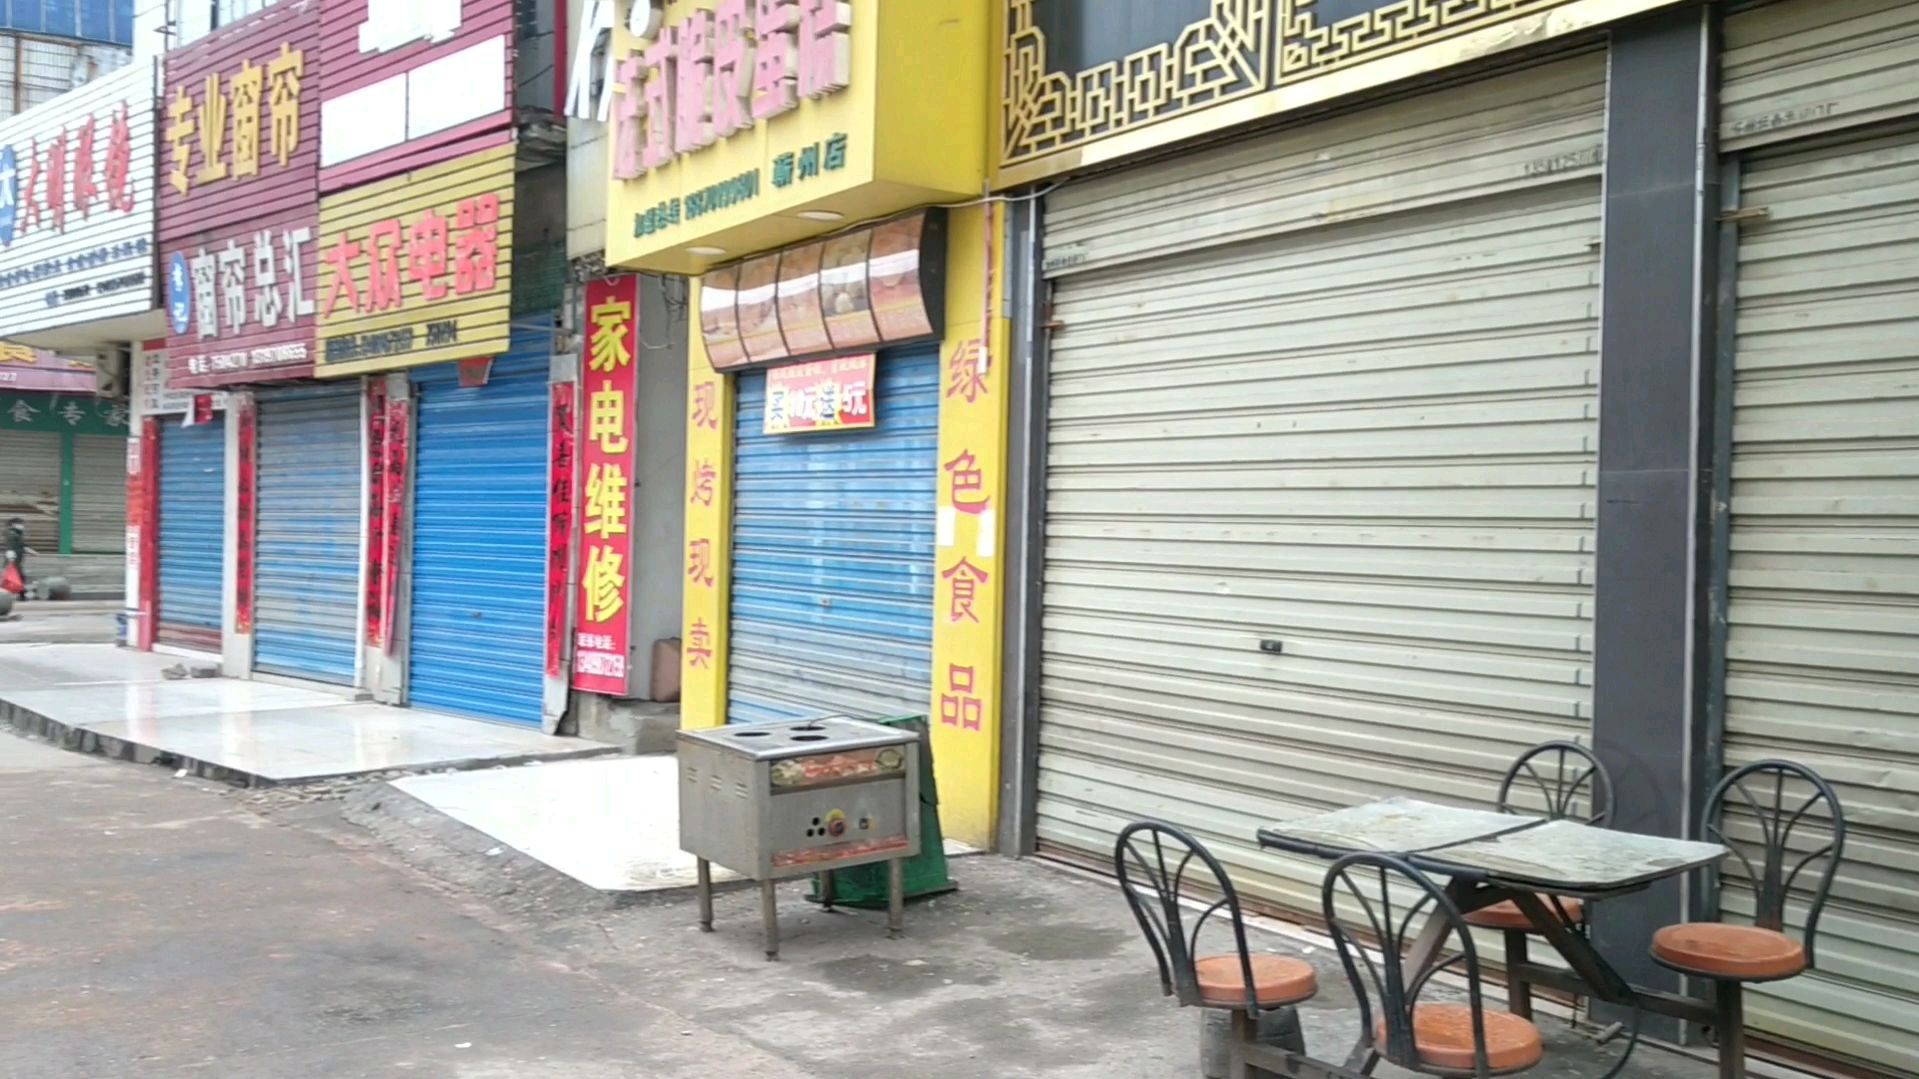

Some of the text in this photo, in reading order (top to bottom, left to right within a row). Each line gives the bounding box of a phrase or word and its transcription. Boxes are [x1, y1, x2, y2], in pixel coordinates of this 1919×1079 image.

[166, 41, 305, 197] 专业窗帘
[190, 227, 316, 341] 窗帘总汇
[323, 194, 501, 318] 大众电器
[581, 296, 633, 624] 家电维修
[687, 381, 719, 670] 现烤现卖
[940, 339, 994, 732] 绿色食品
